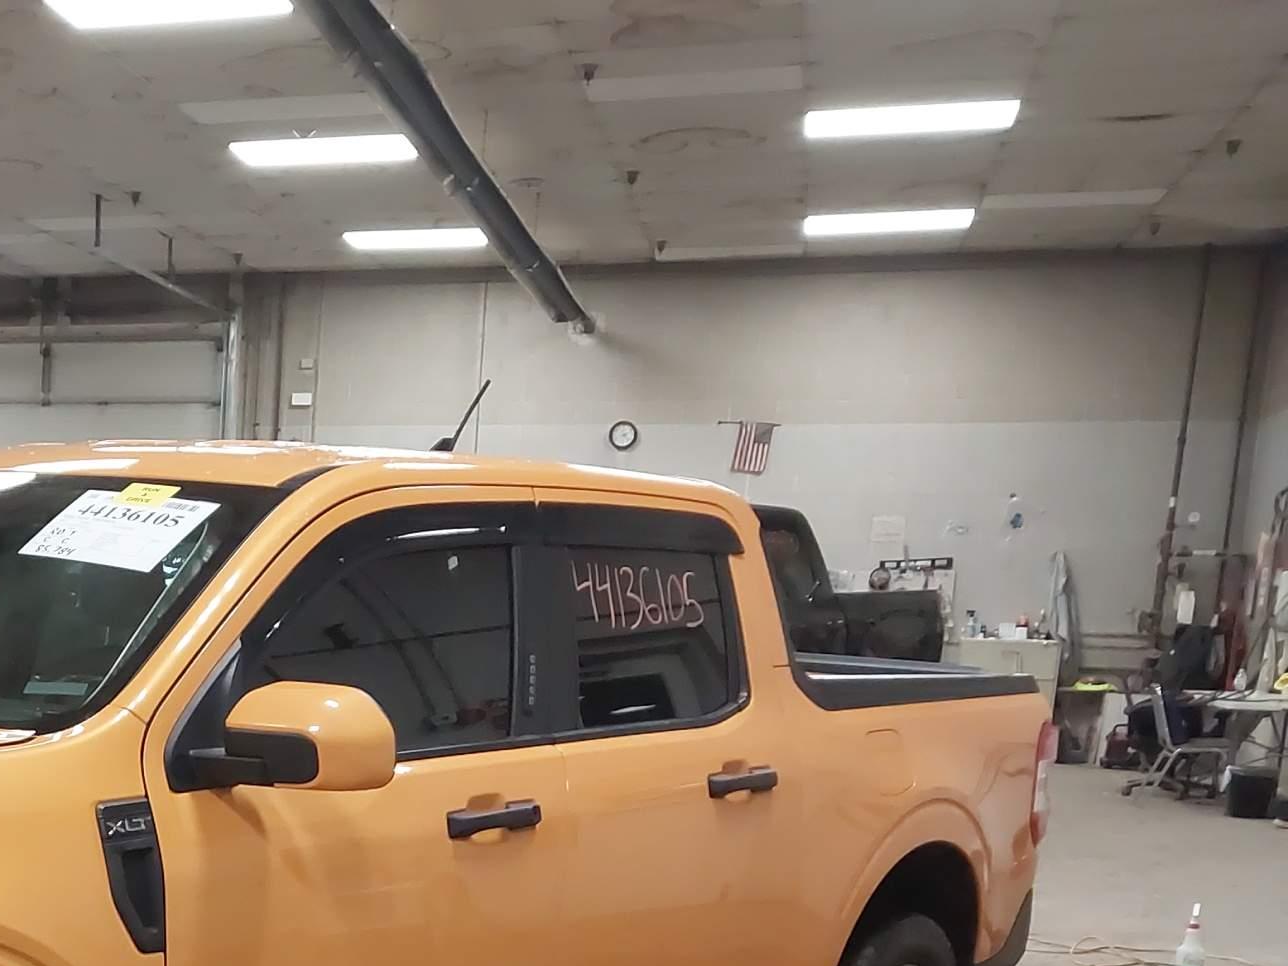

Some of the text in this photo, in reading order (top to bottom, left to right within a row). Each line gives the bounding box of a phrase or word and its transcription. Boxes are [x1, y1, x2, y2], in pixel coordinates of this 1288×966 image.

[78, 504, 185, 528] 44136105
[570, 559, 705, 630] 44136105
[106, 817, 151, 836] XLT
